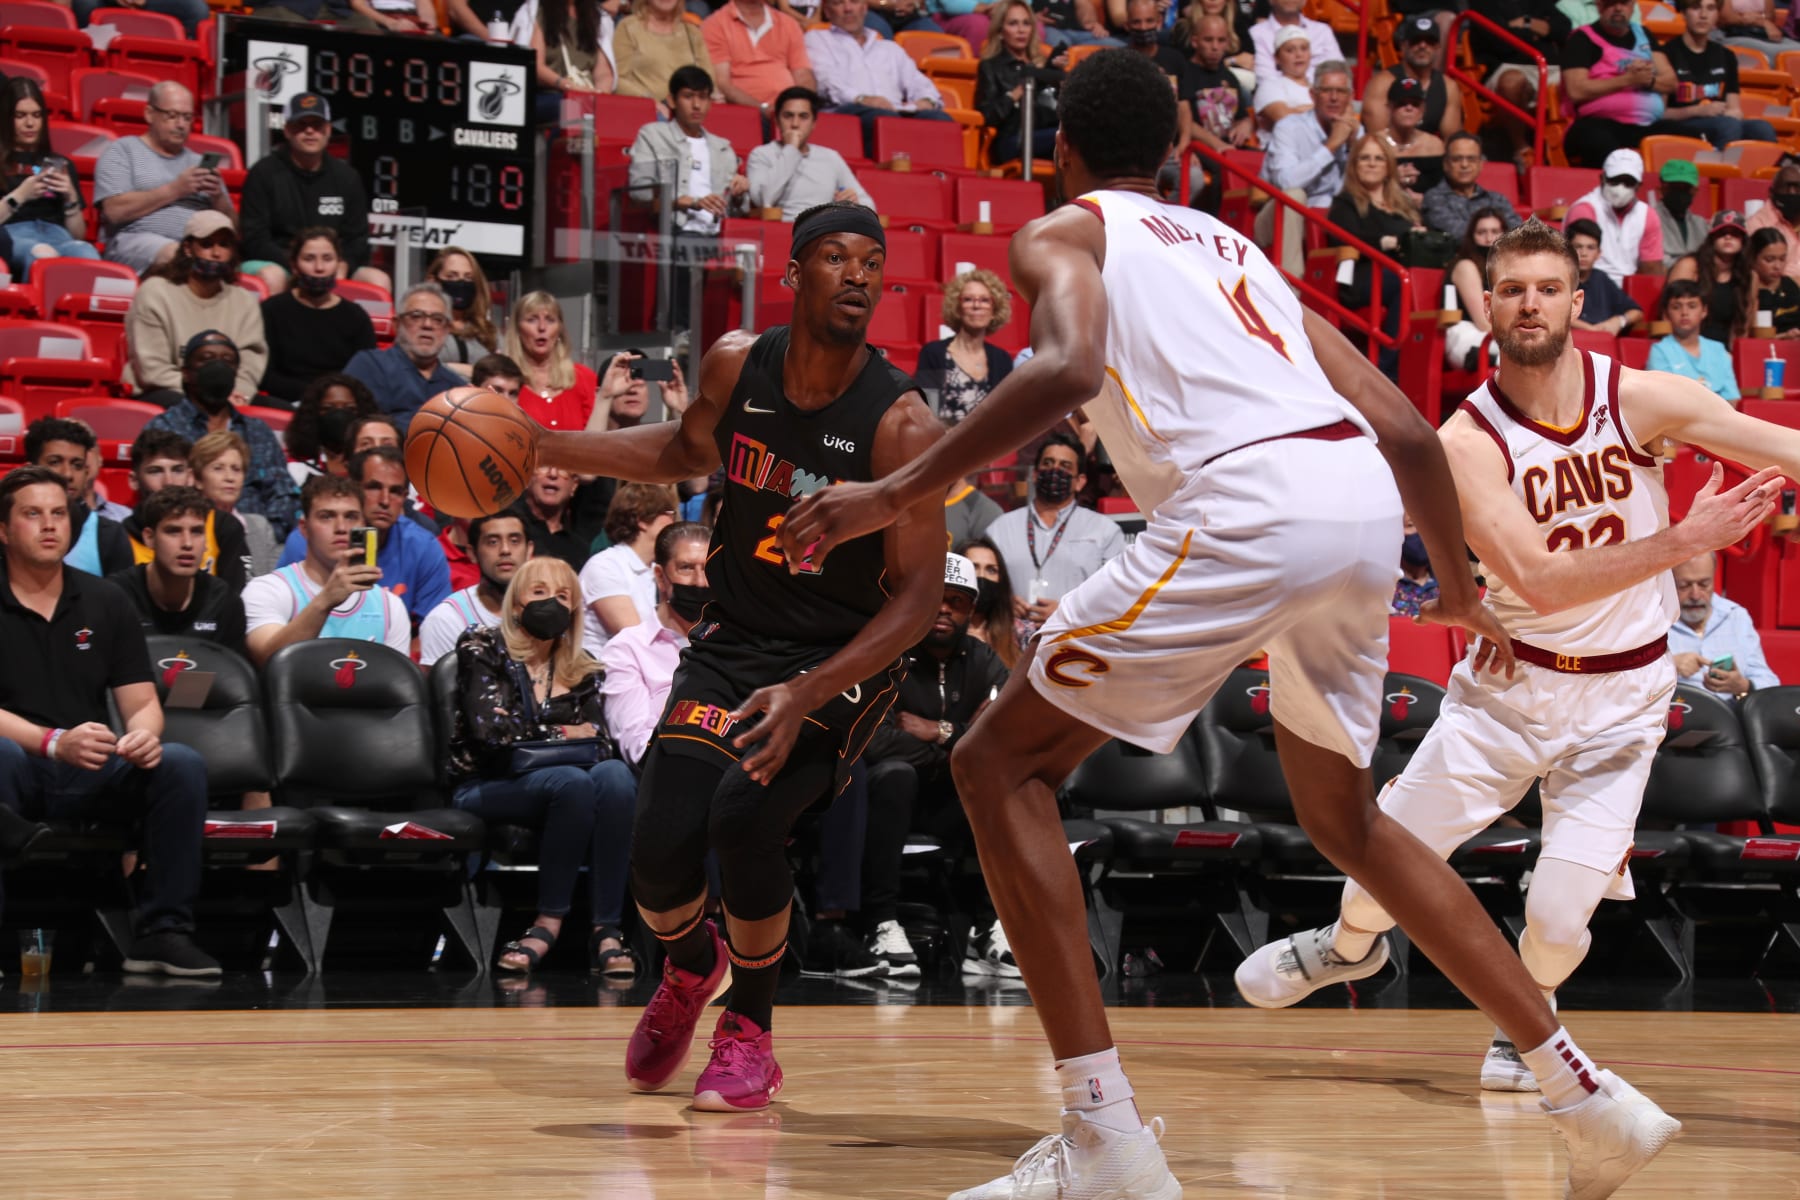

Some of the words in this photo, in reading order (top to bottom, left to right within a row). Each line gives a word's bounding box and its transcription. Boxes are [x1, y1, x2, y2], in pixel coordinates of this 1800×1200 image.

[454, 127, 518, 150] CAVALIERS
[1217, 272, 1296, 366] 4
[1522, 444, 1633, 525] CAVS
[1555, 653, 1582, 671] CLE
